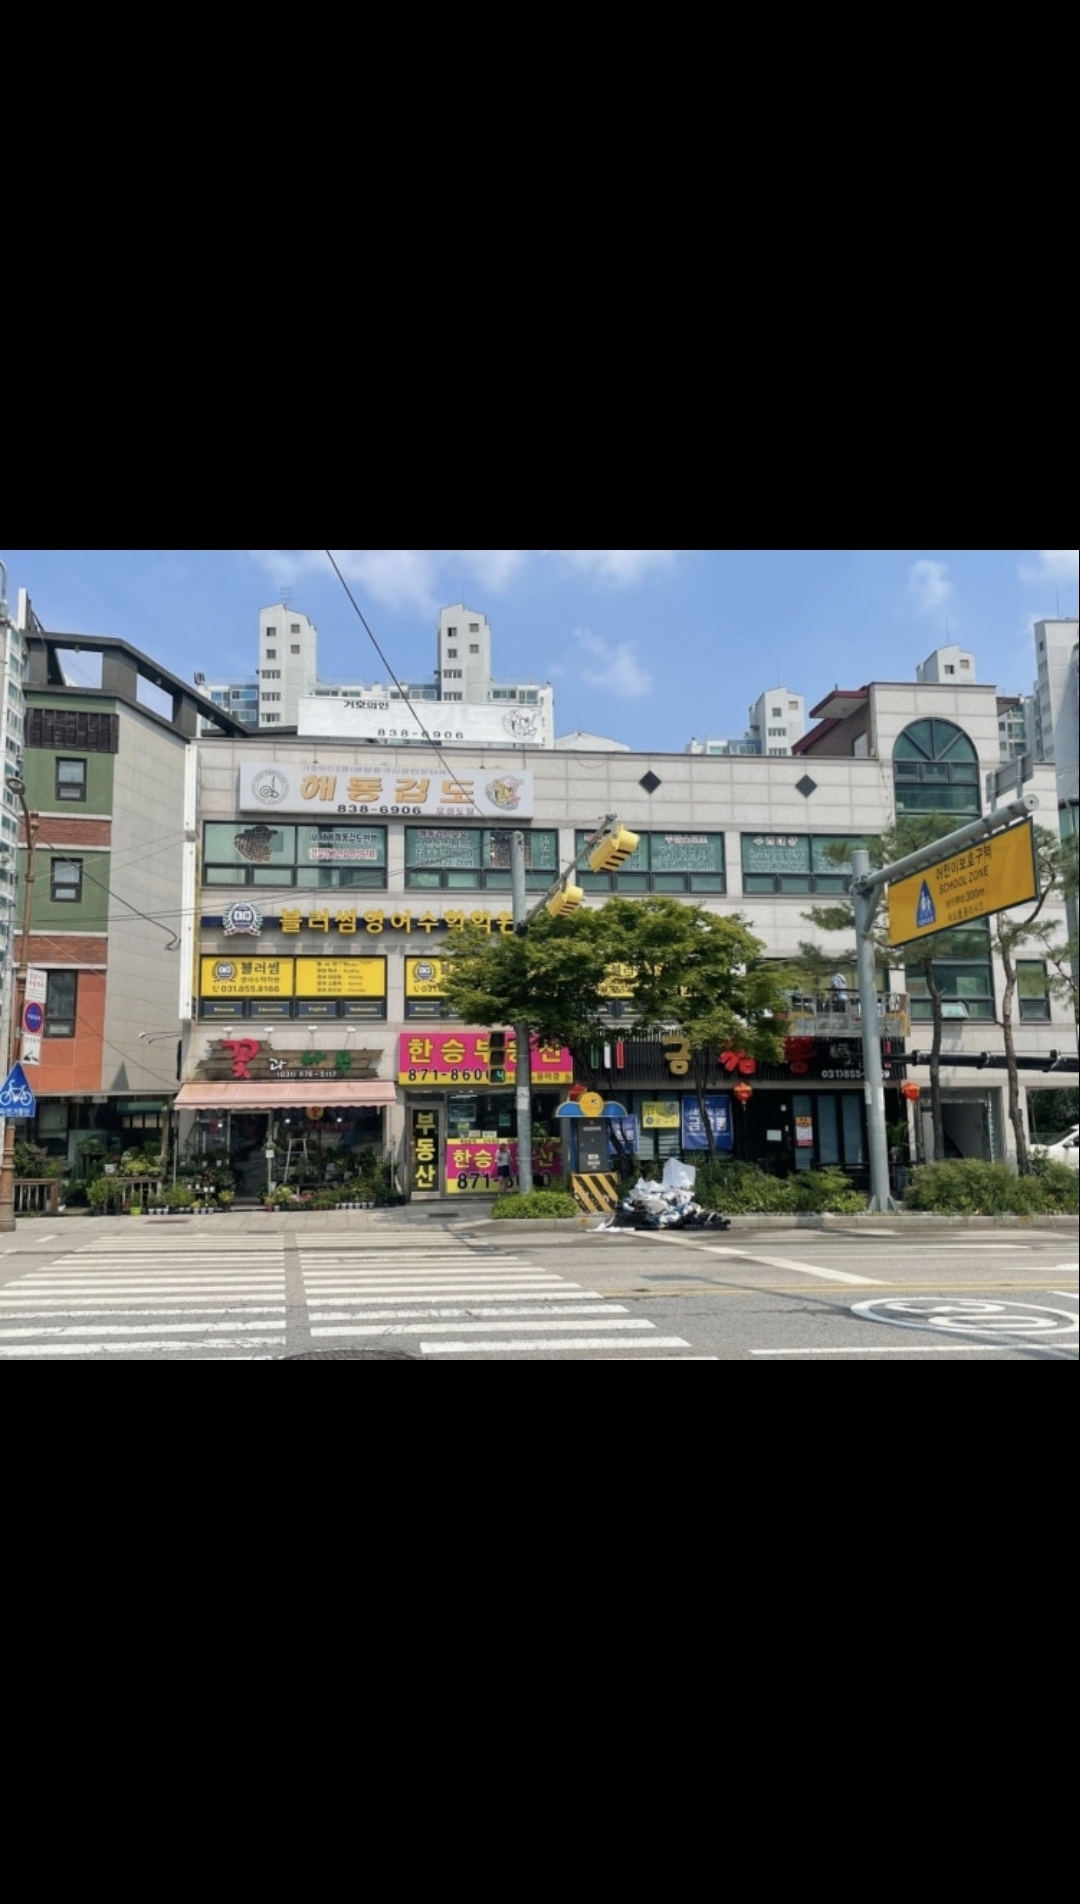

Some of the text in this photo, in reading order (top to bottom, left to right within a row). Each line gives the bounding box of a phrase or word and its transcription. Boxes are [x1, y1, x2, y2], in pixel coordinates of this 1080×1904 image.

[377, 728, 464, 740] 838-6906
[300, 774, 475, 804] 해동검도
[337, 804, 422, 815] 838-6906
[936, 843, 992, 881] 어린이보호구역
[939, 864, 989, 895] SCHOOL ZONE
[242, 961, 280, 975] 블러썸
[221, 985, 280, 993] 031.855.8166
[408, 1068, 490, 1082] 871-860
[821, 1069, 890, 1079] 031)855-9
[415, 1112, 436, 1189] 부동산
[453, 1149, 554, 1169] 한승산
